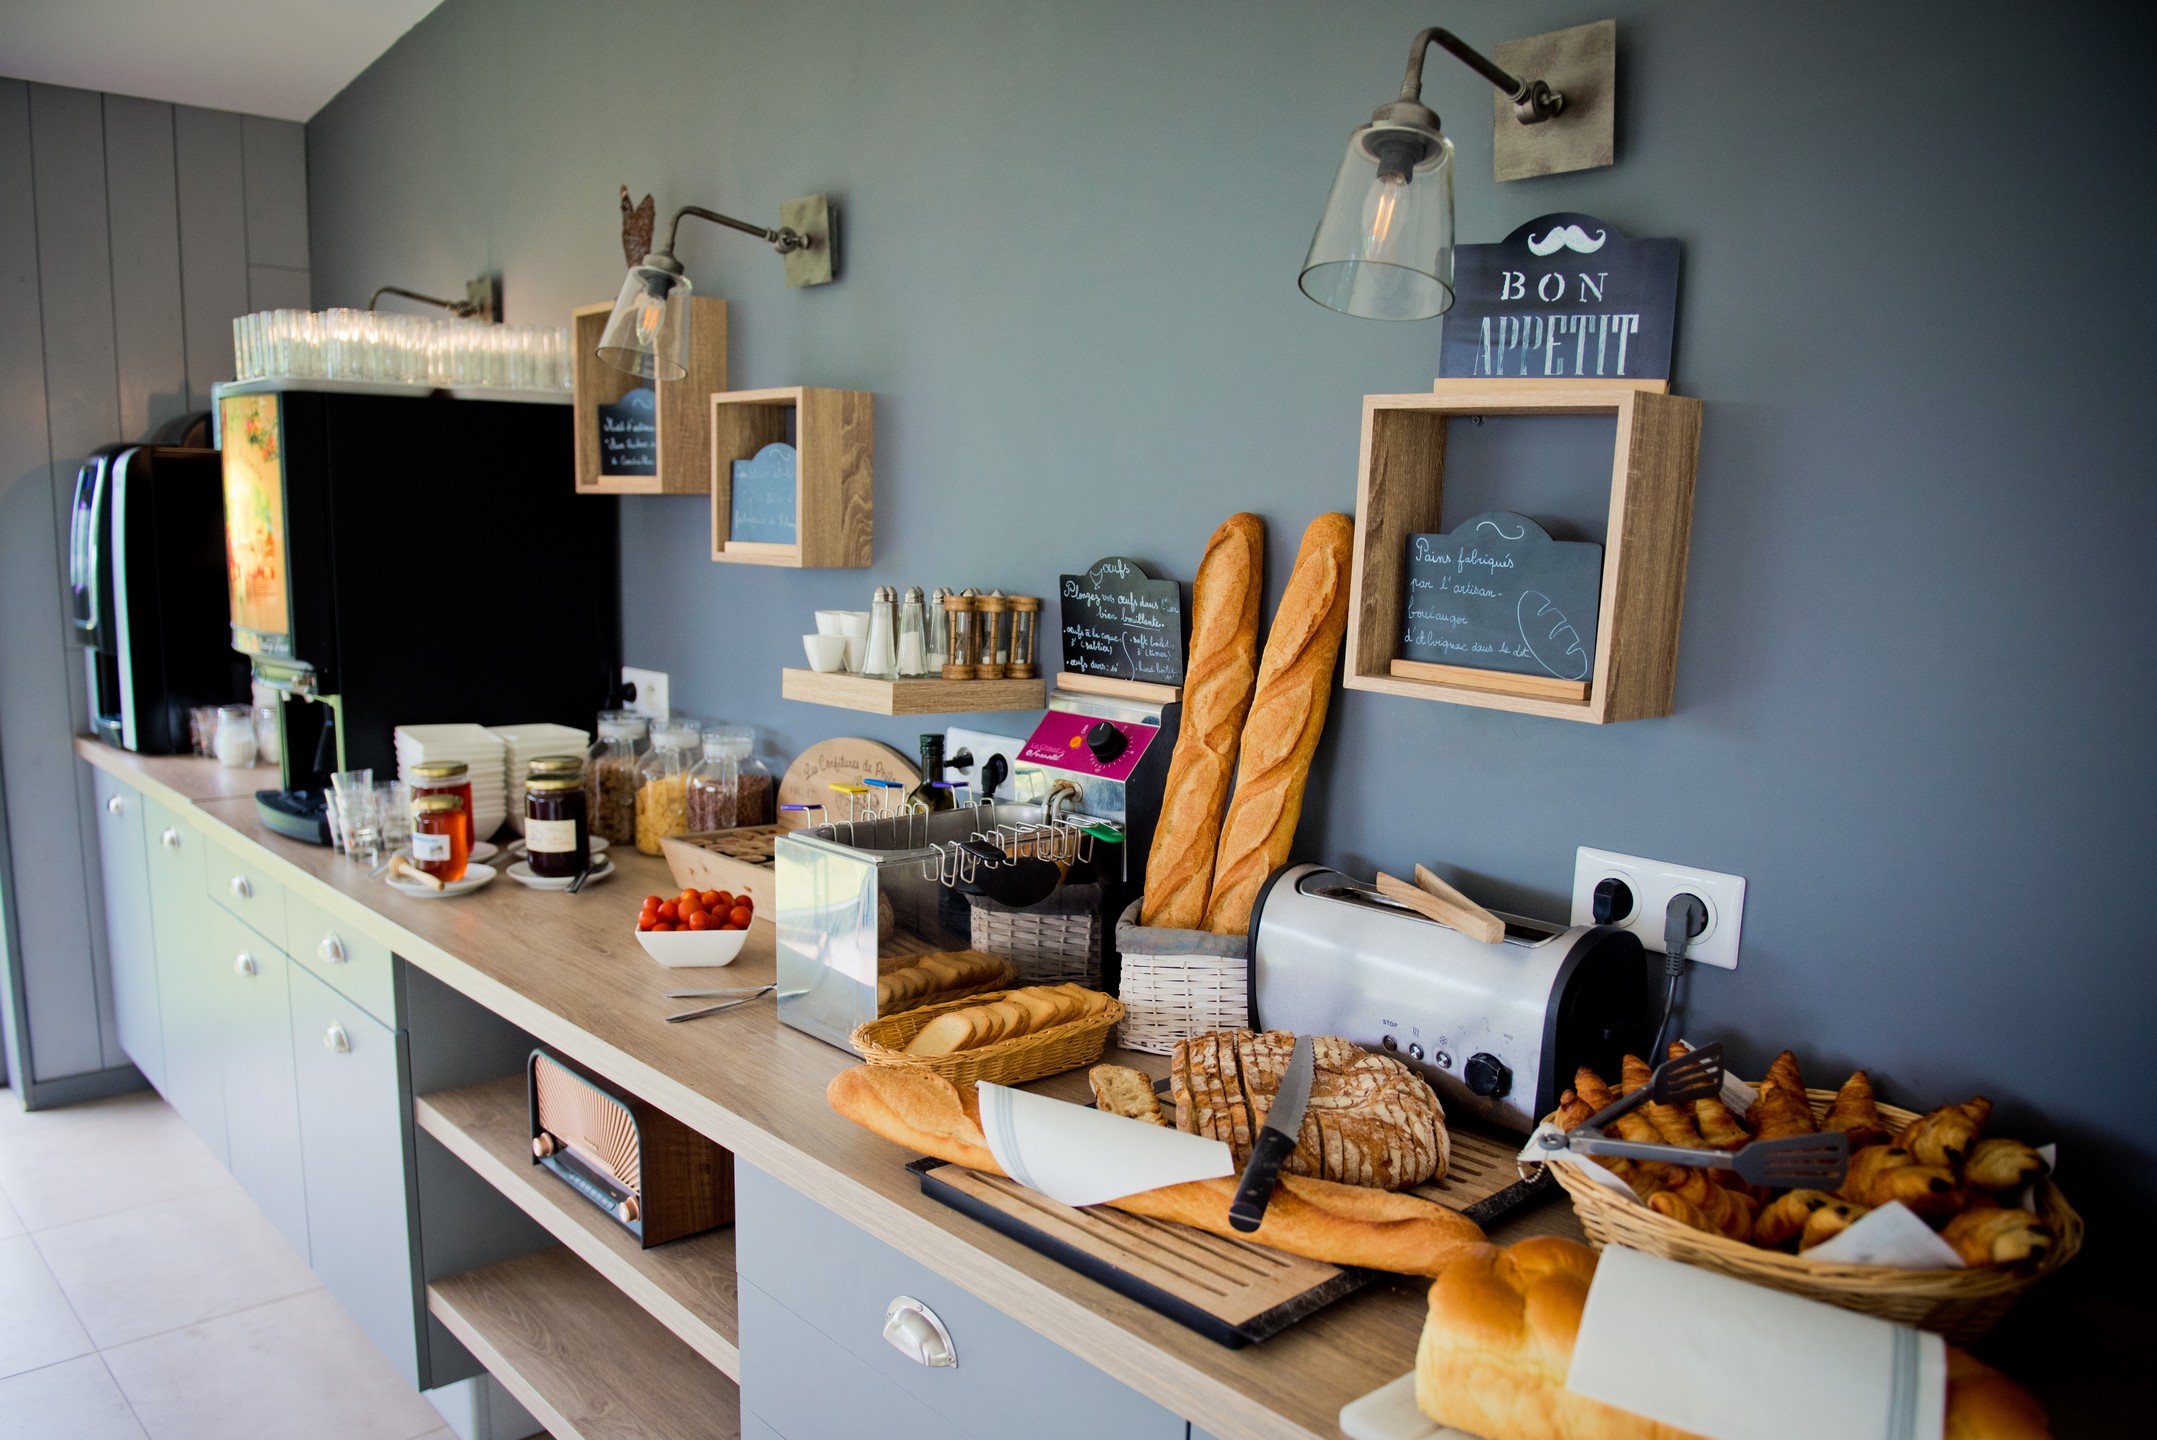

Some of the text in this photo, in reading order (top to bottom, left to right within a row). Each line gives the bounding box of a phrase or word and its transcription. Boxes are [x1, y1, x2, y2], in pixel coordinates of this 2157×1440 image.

[1500, 271, 1609, 303] BON
[1472, 313, 1640, 376] APPETIT
[1415, 537, 1514, 575] Pains fabriqués
[1410, 578, 1434, 593] par
[1407, 595, 1468, 630] boulanger
[1471, 642, 1494, 653] dans
[1382, 1019, 1398, 1028] STOP
